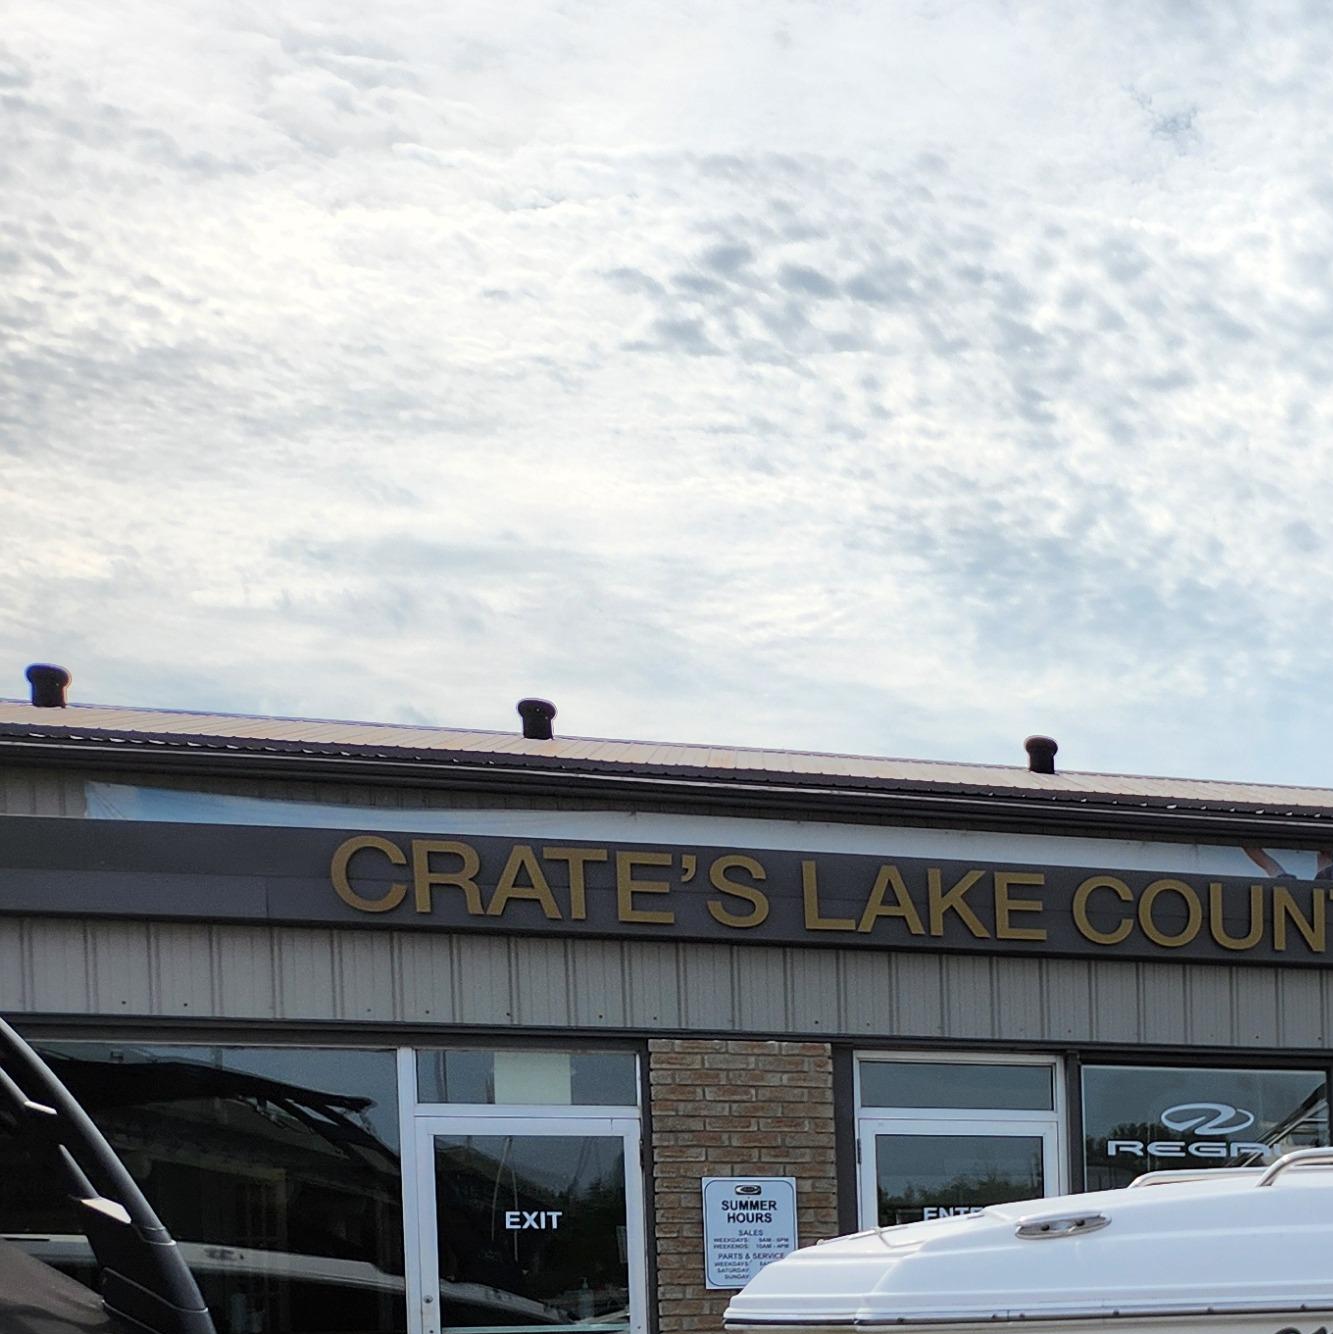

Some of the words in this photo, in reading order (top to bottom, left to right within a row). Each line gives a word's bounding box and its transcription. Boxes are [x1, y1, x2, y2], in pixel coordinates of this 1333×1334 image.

[330, 835, 771, 929] CRATE'S
[801, 859, 1048, 941] LAKE
[721, 1200, 777, 1211] SUMMER
[505, 1211, 563, 1229] EXIT
[727, 1212, 773, 1223] HOURS
